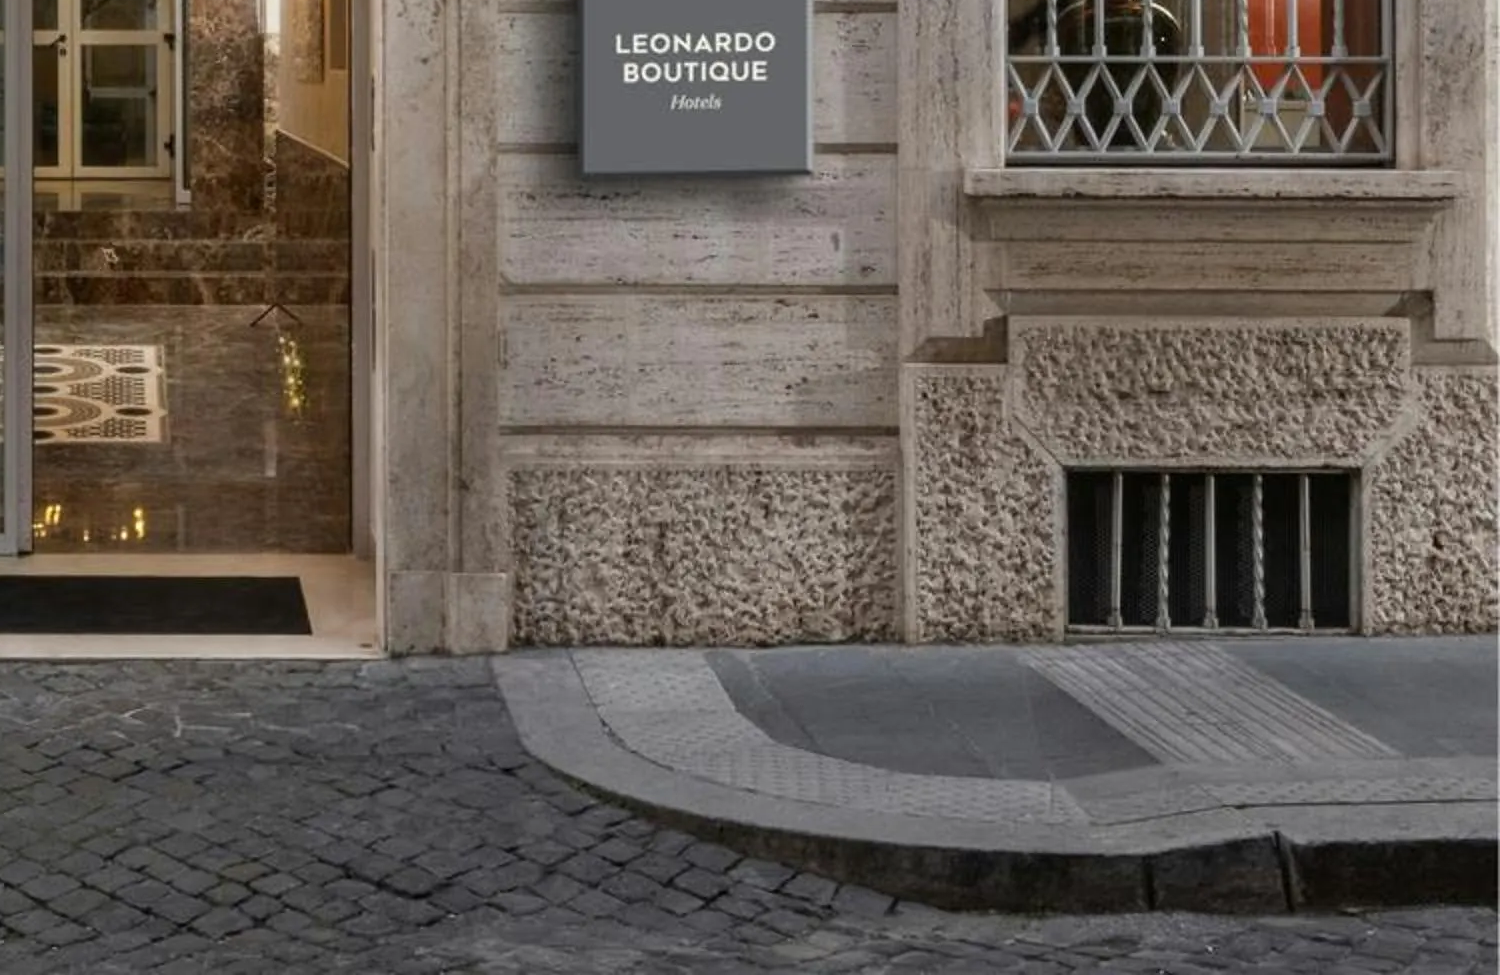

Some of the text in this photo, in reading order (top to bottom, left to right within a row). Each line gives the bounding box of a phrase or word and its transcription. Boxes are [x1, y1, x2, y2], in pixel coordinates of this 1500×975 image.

[615, 31, 776, 54] LEONARDO
[623, 61, 768, 83] BOUTIQUE
[670, 93, 722, 110] Hotels
